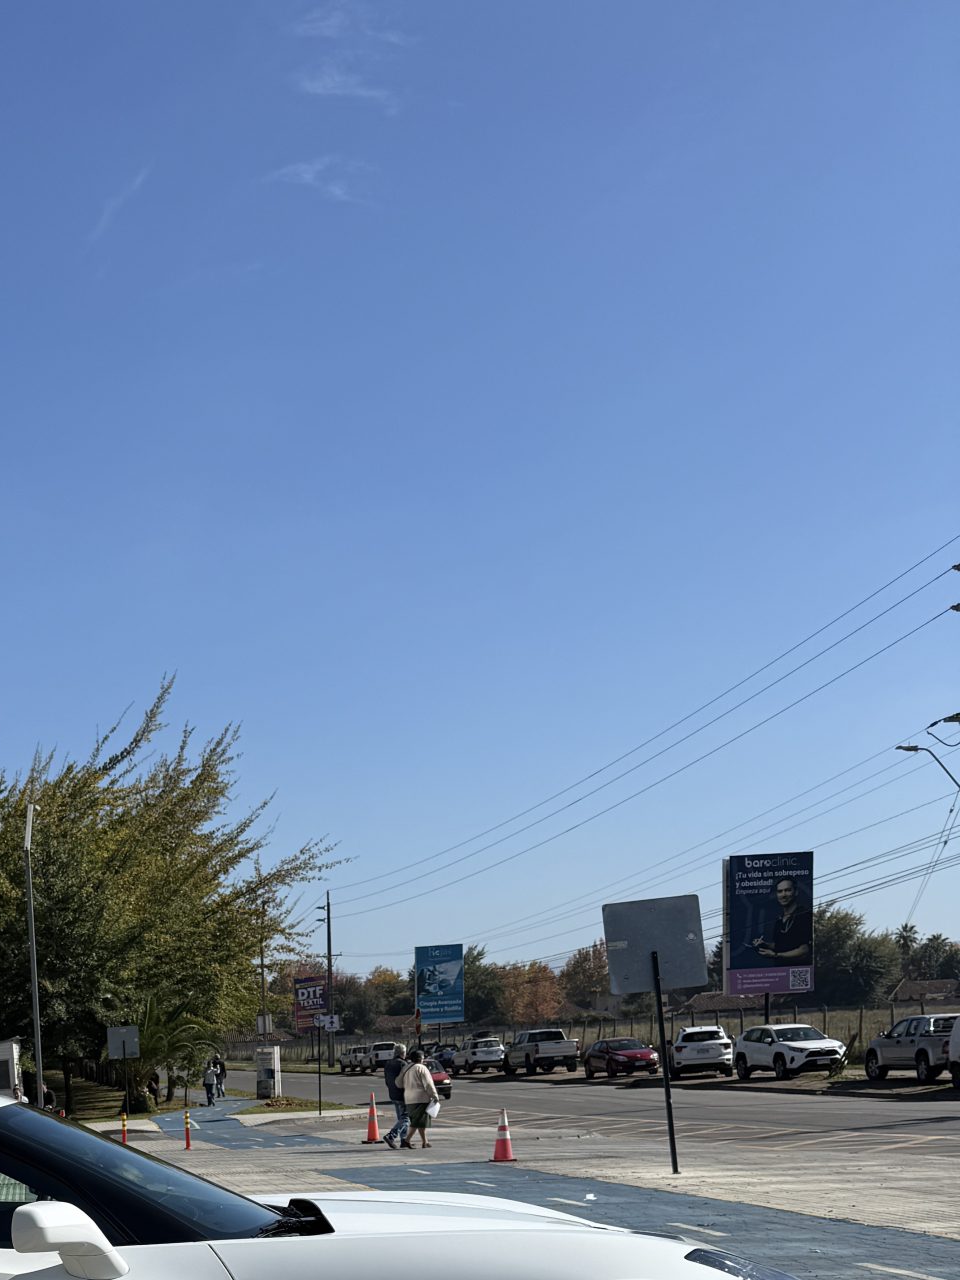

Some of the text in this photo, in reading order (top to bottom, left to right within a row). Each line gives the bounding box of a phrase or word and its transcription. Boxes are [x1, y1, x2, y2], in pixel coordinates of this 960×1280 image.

[735, 871, 746, 880] ¡Tu
[774, 869, 810, 877] sobrepeso
[741, 879, 773, 887] obesidad!
[298, 986, 324, 1000] DTF
[300, 998, 324, 1007] TEXTIL
